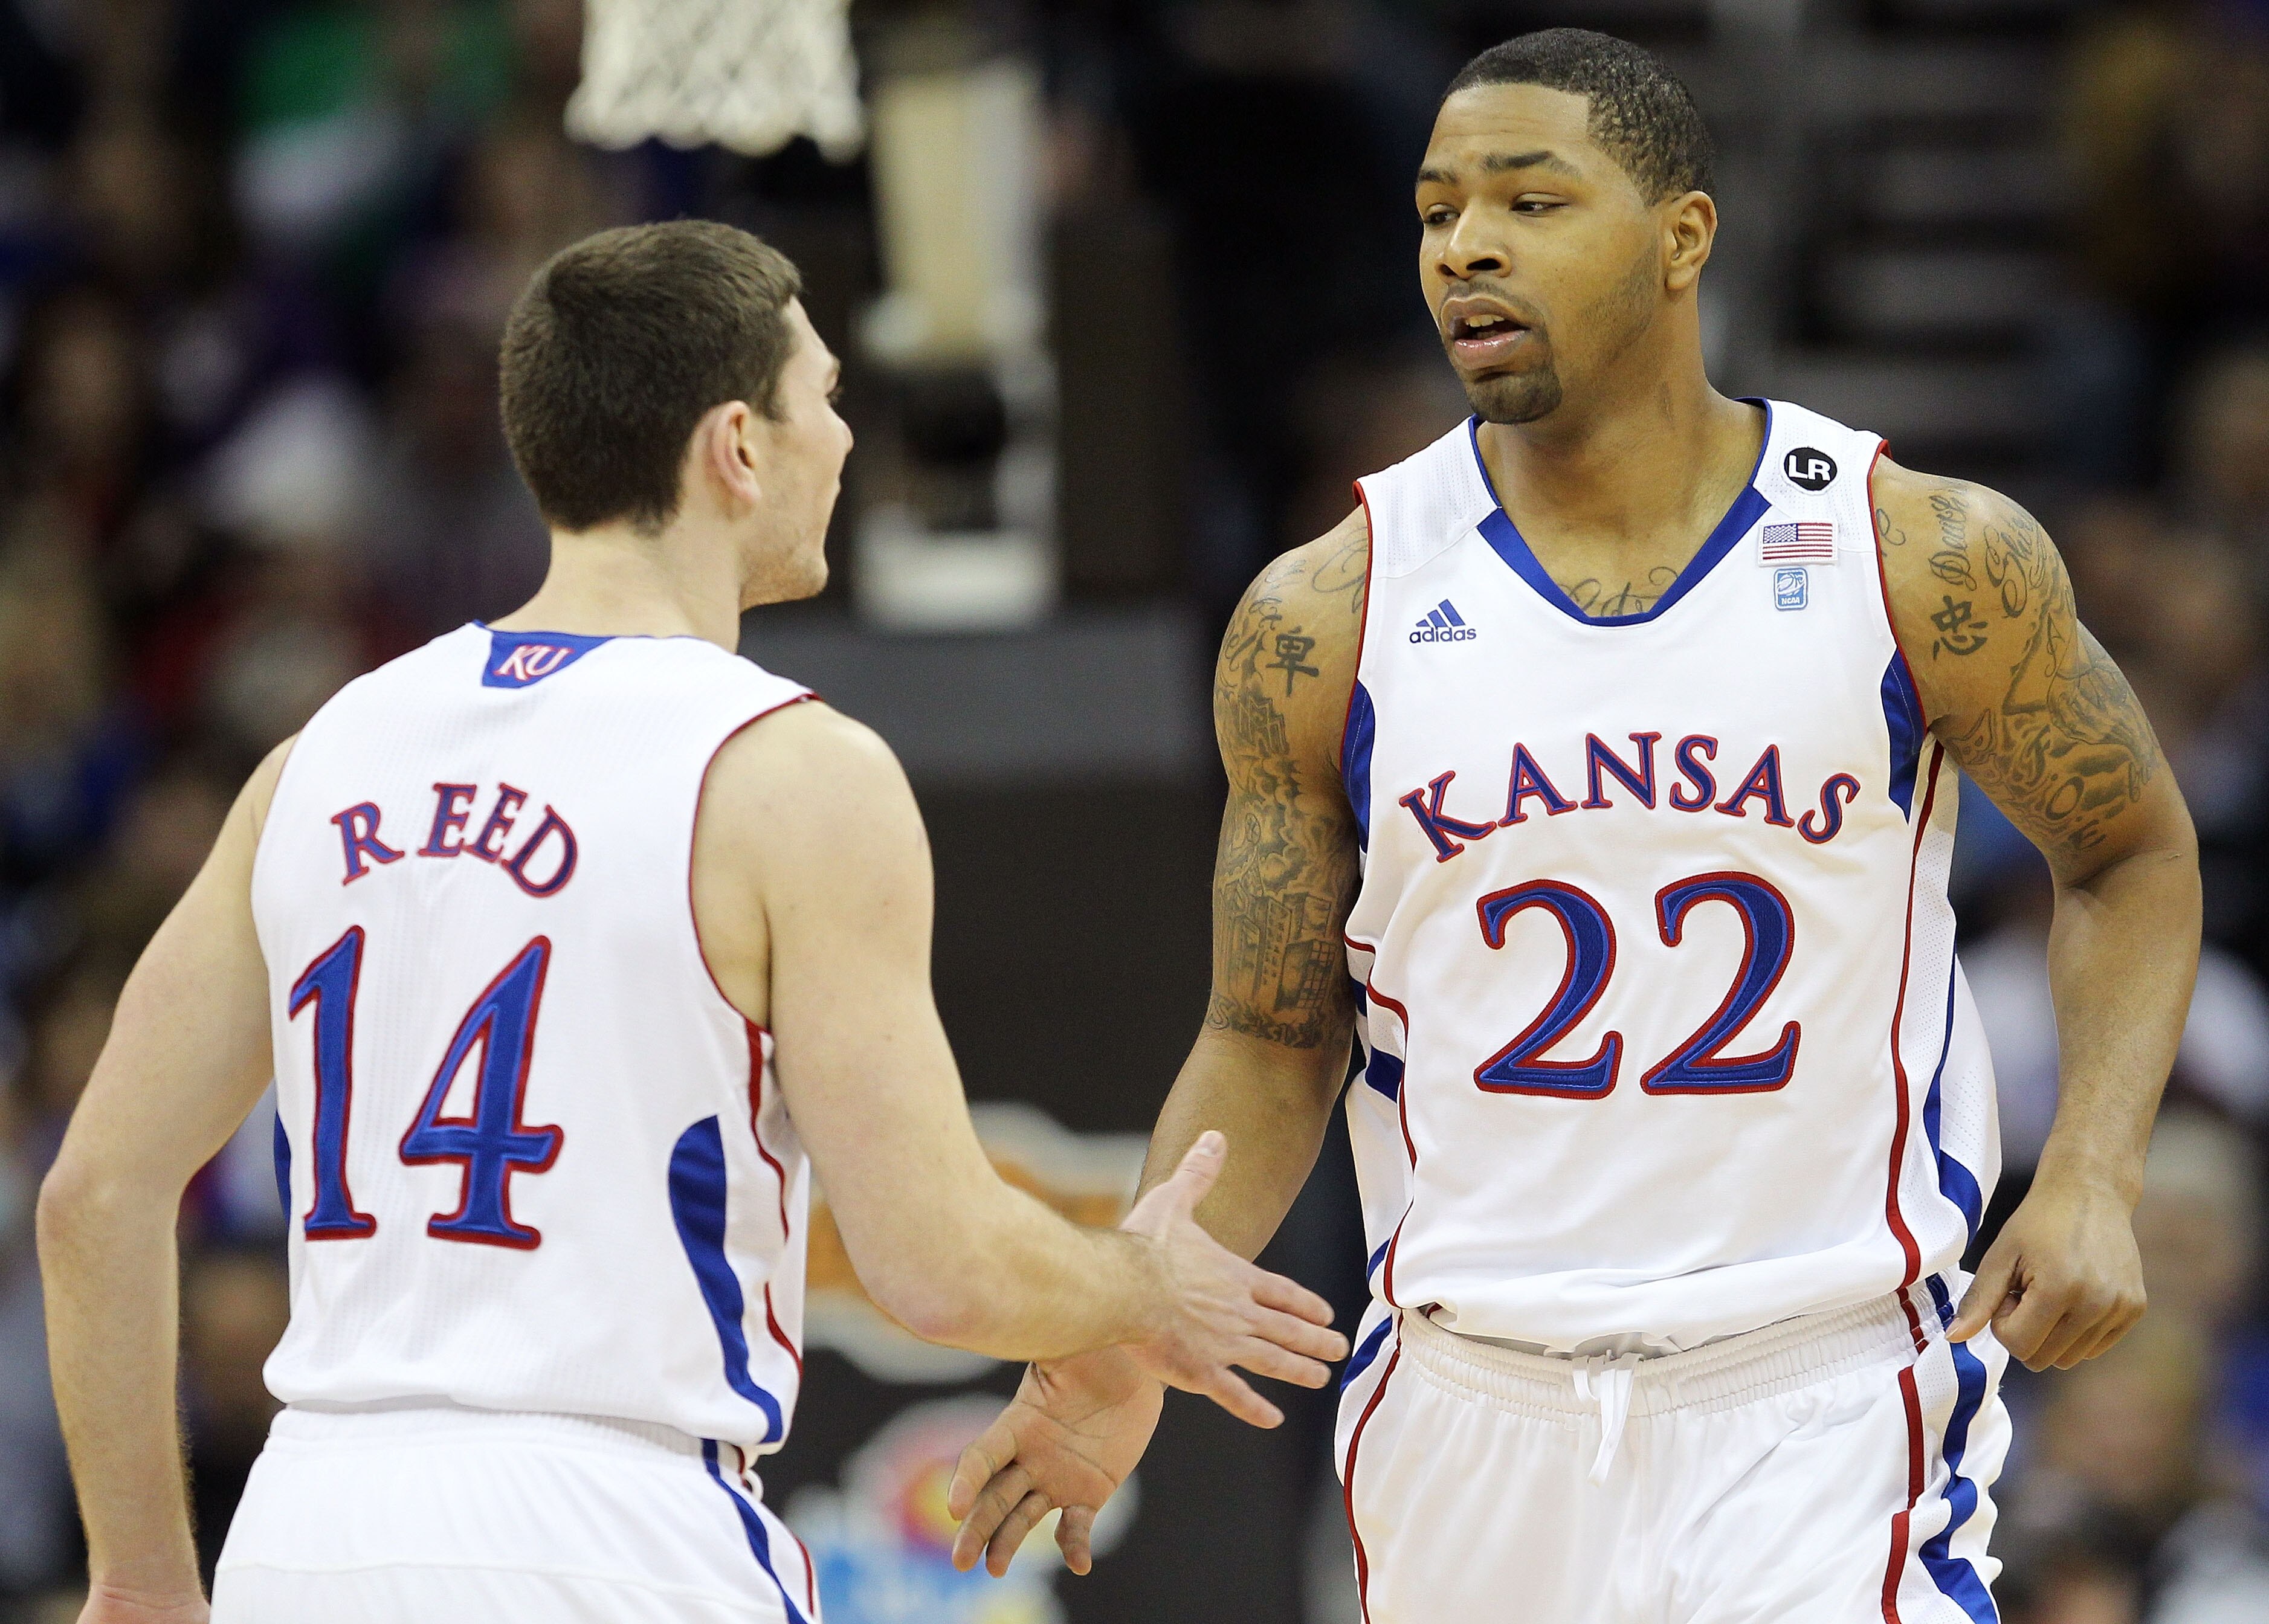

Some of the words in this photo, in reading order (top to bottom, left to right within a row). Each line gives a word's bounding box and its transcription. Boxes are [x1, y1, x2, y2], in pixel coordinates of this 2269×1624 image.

[1788, 454, 1831, 482] LR
[493, 644, 576, 682] KU
[1409, 627, 1477, 644] adidas
[331, 782, 578, 899] REED
[1399, 731, 1861, 863] KANSAS
[1473, 871, 1801, 1100] 22
[288, 924, 564, 1251] 14
